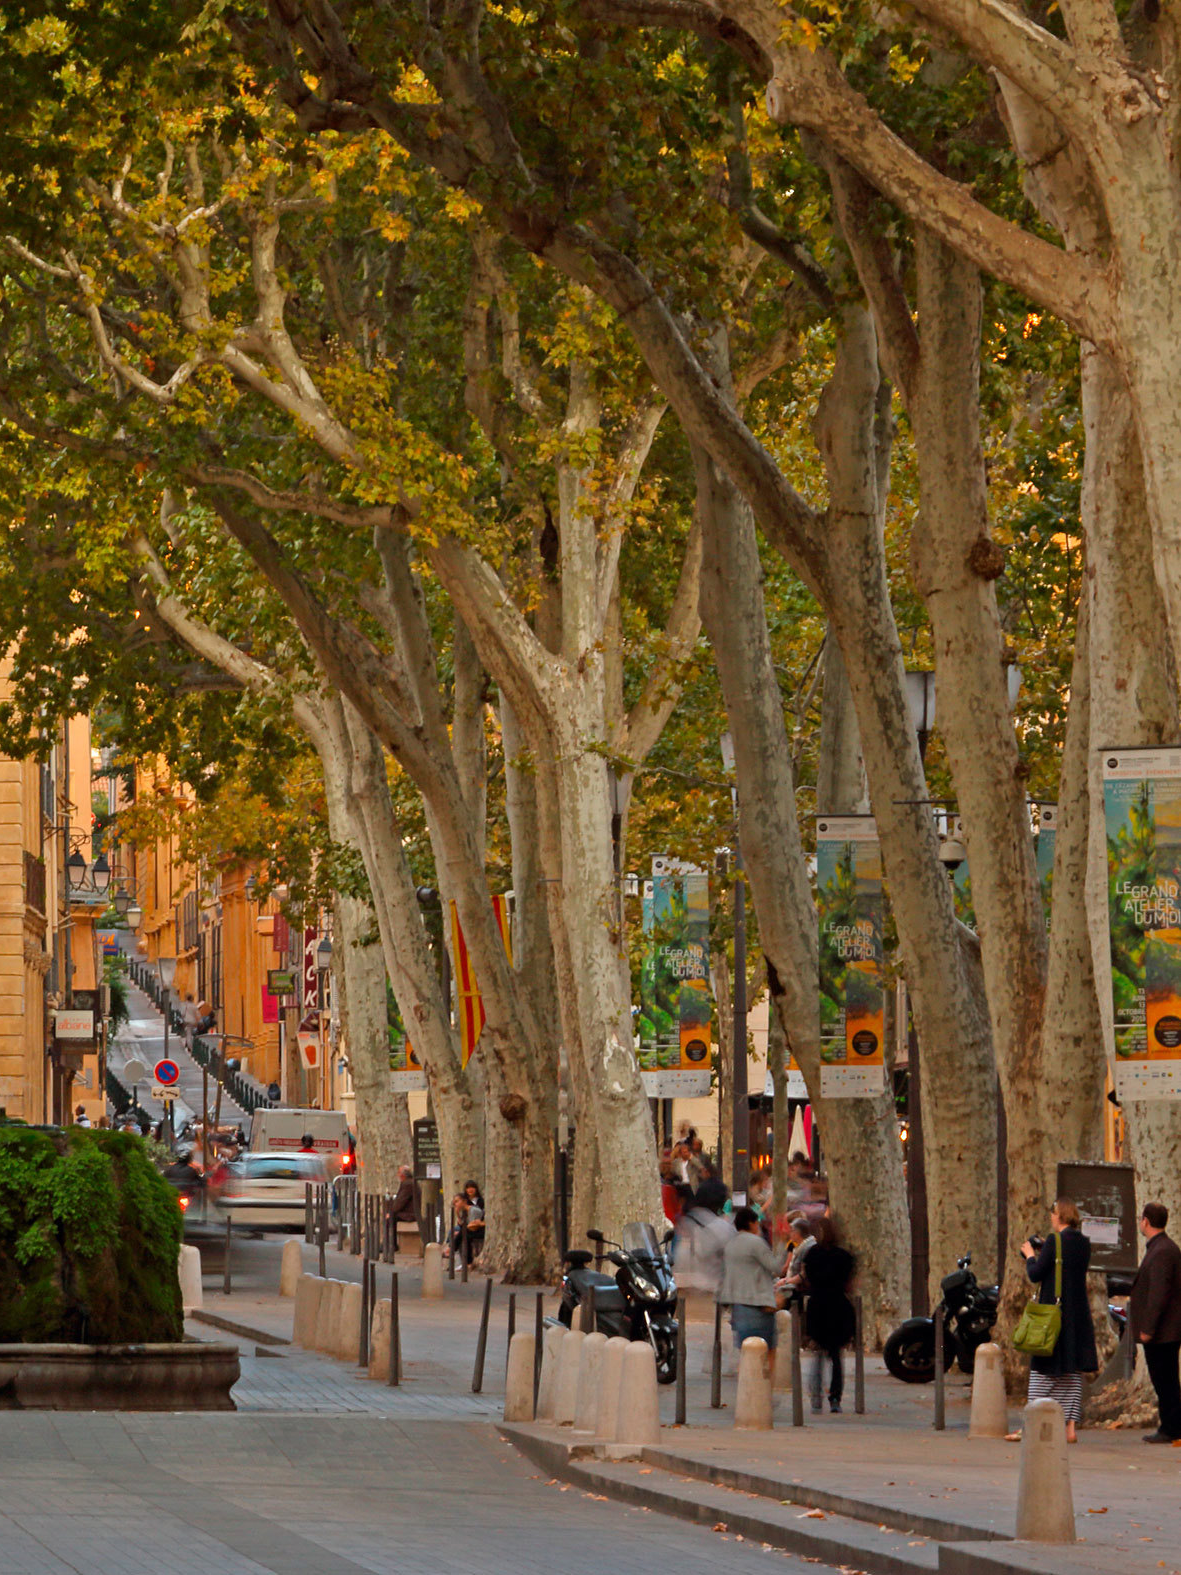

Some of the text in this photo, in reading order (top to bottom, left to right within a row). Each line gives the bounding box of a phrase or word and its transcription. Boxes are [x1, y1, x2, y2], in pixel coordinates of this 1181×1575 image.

[1115, 881, 1178, 898] LE GRAND
[1124, 898, 1175, 913] ATELIER
[1135, 910, 1181, 927] DU MIDI
[823, 922, 874, 937] LE GRAND
[829, 935, 871, 947] ATELIER
[659, 946, 703, 959] LE GRAND
[838, 945, 876, 958] DU MIDI
[665, 959, 701, 968] ATELIER
[672, 965, 706, 978] DU MIDI
